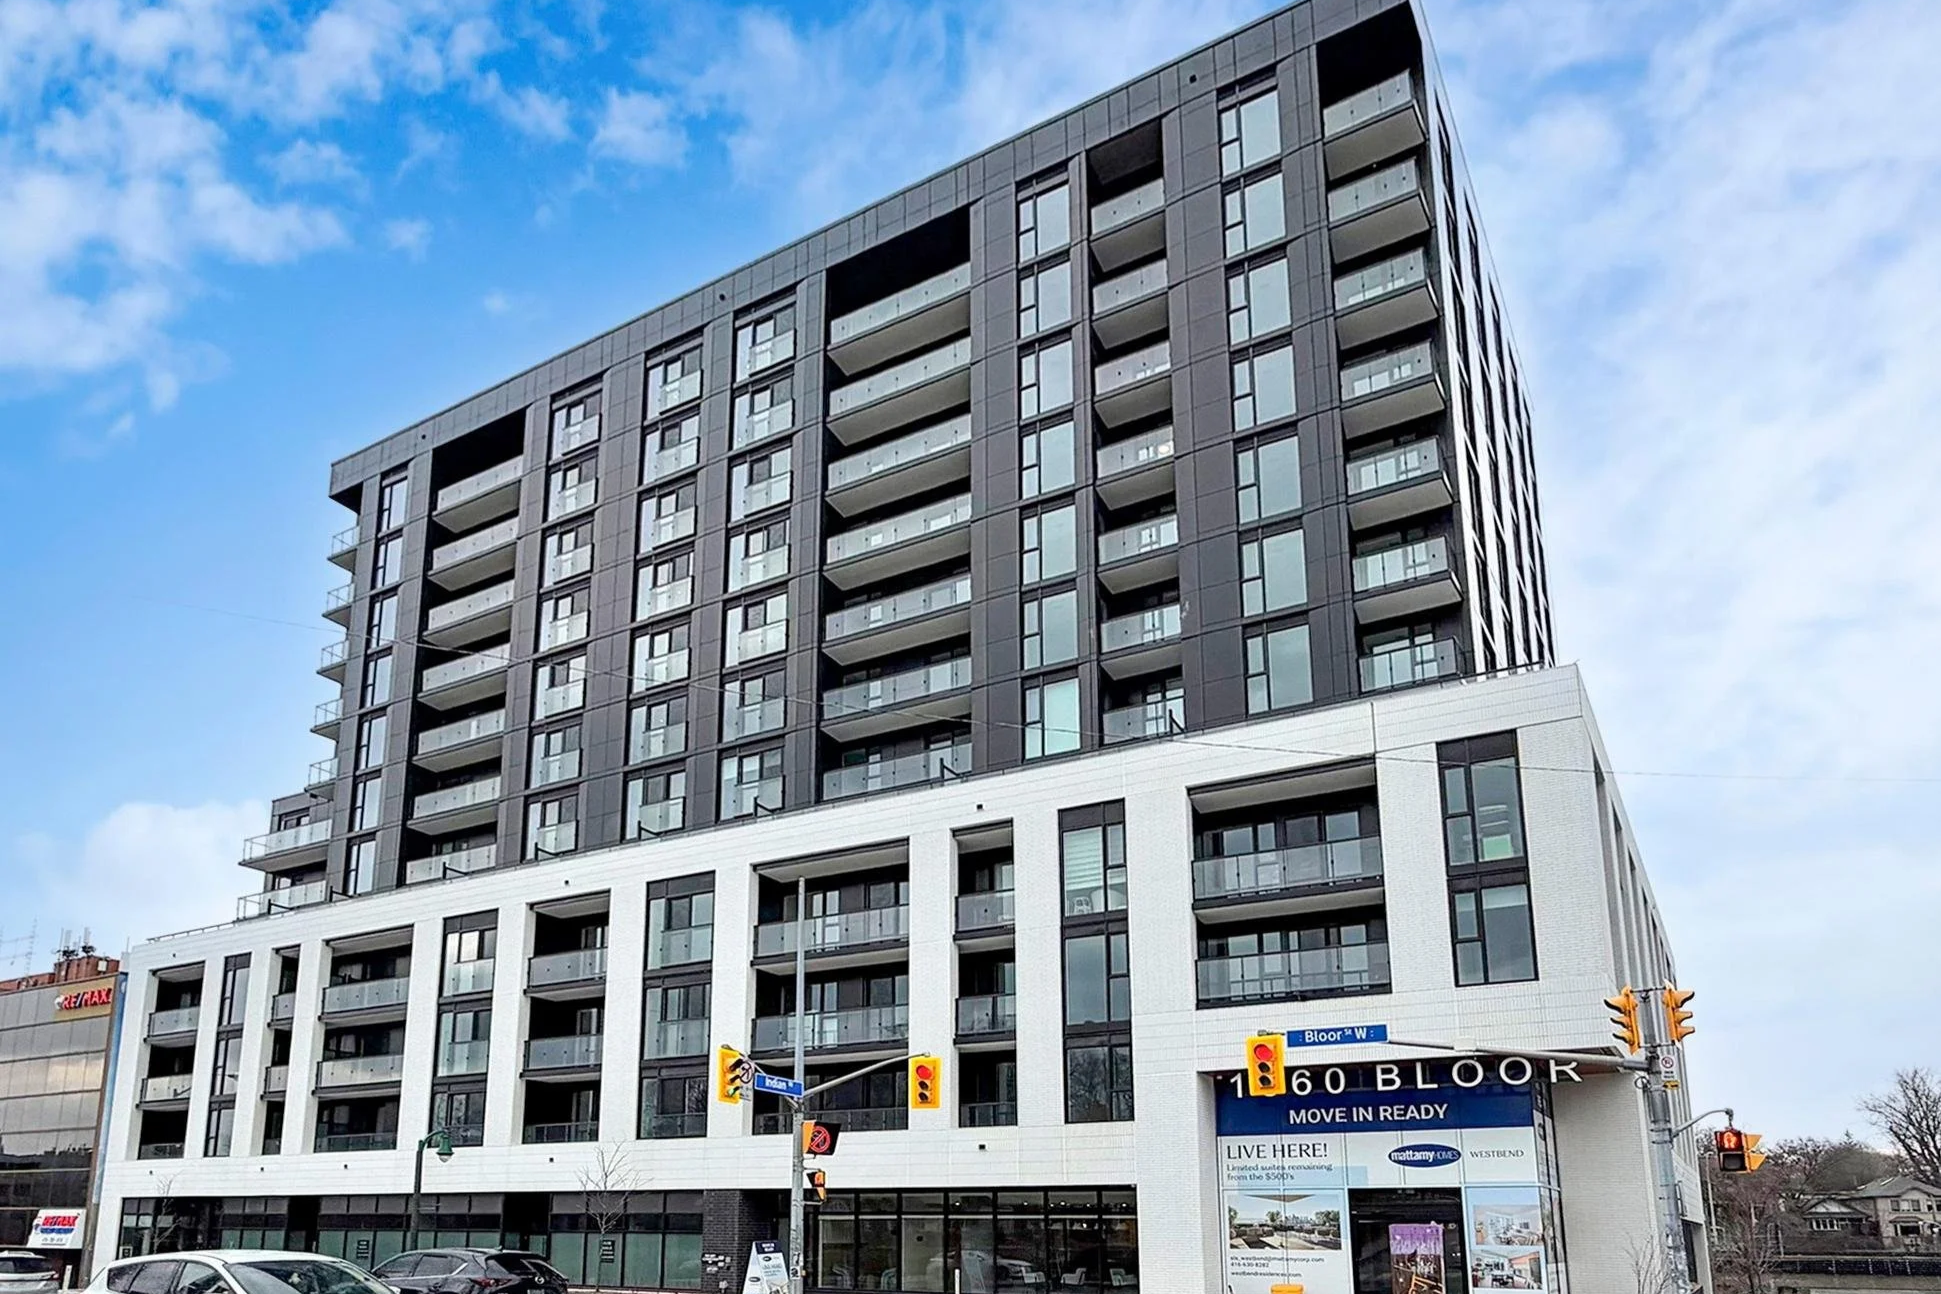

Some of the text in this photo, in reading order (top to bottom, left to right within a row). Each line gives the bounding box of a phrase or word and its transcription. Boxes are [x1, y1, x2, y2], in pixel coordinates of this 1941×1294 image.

[63, 988, 112, 1010] RE/MAX
[1304, 1030, 1342, 1043] Bloor
[1354, 1027, 1367, 1040] W
[1230, 1056, 1584, 1098] 160 BLOOR
[1289, 1104, 1448, 1124] MOVE IN READY
[1227, 1143, 1328, 1159] LIVE HERE!
[1470, 1149, 1524, 1158] WESTBEND
[1227, 1163, 1333, 1172] Limited suites remaining
[1227, 1172, 1295, 1181] from the $500's
